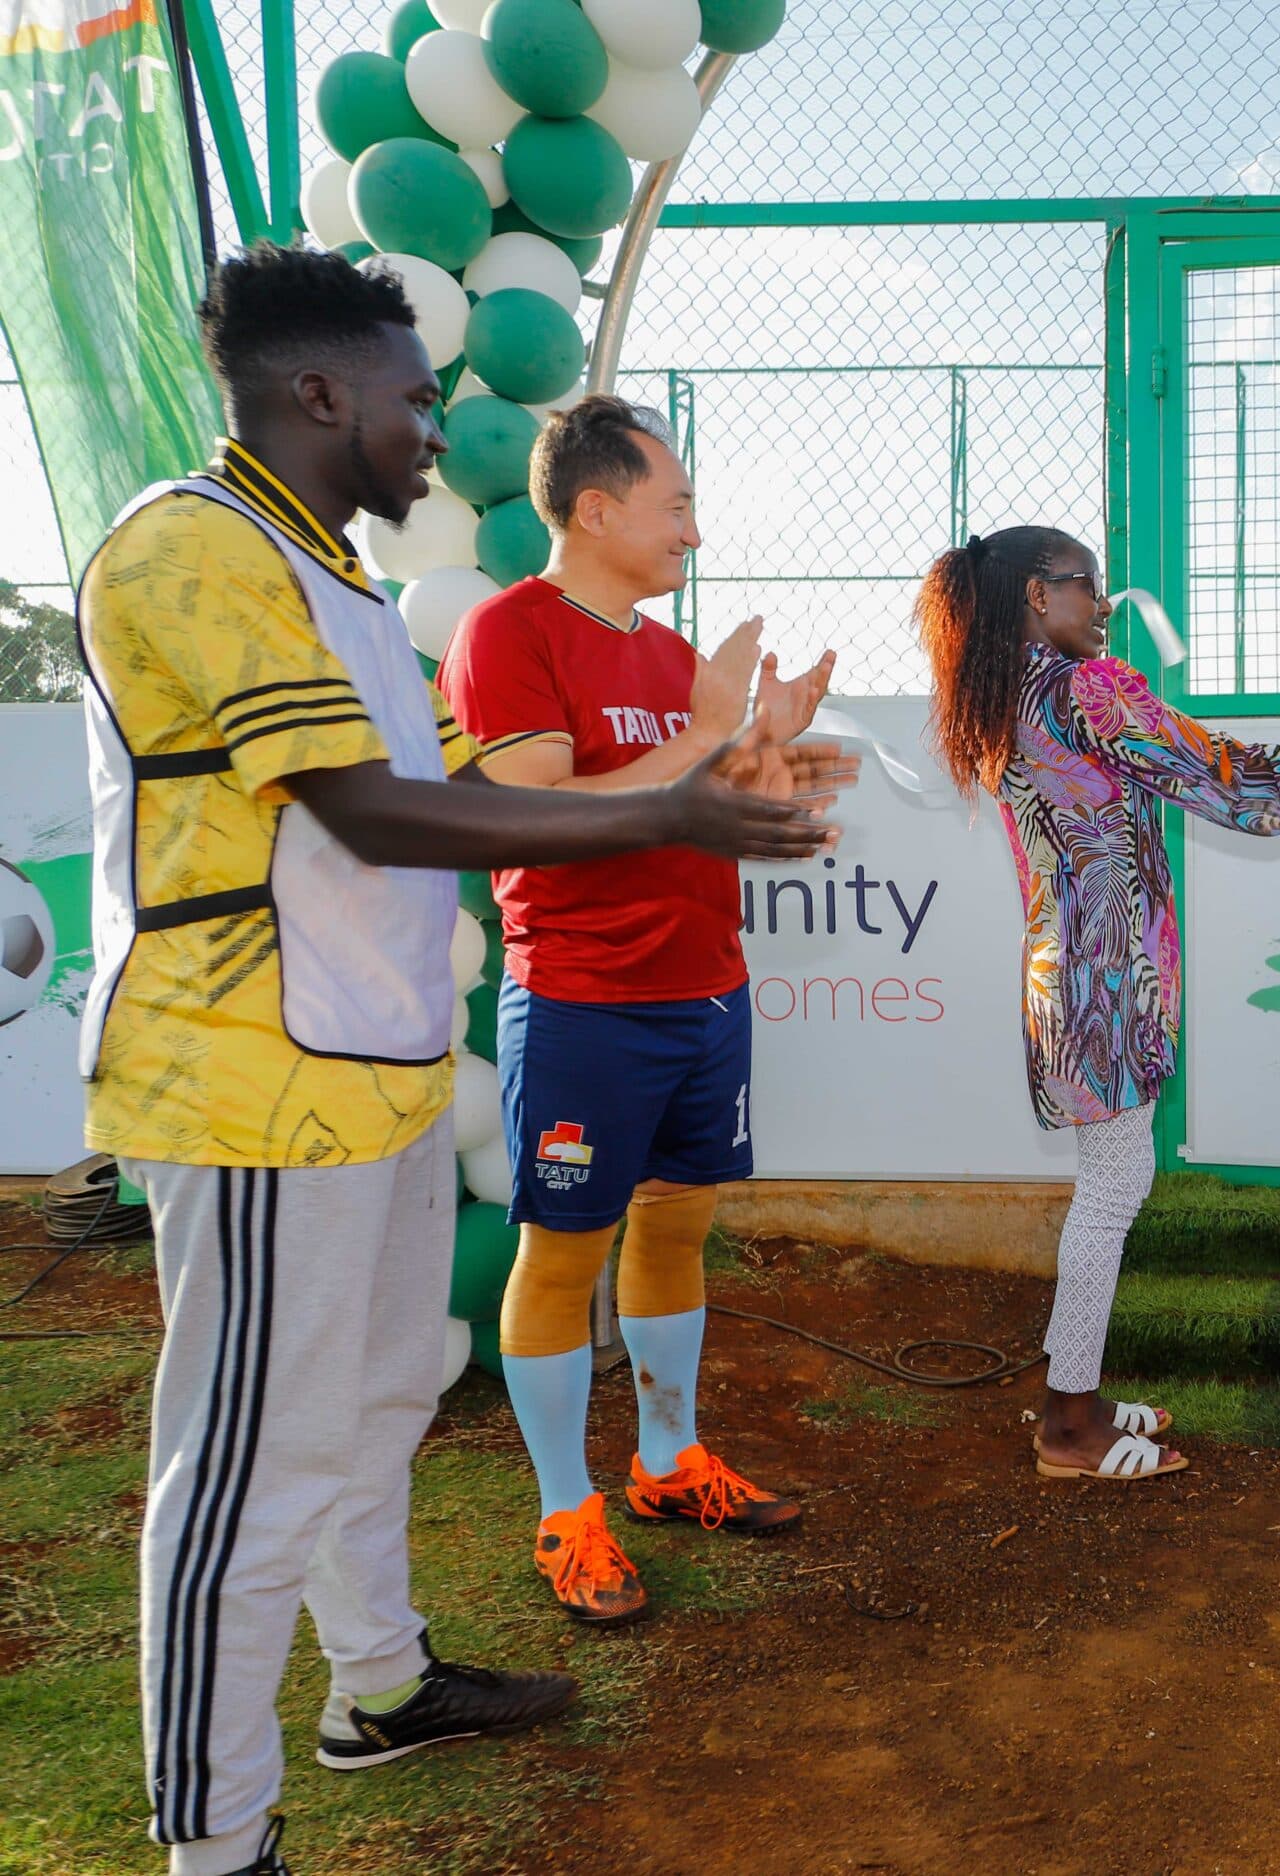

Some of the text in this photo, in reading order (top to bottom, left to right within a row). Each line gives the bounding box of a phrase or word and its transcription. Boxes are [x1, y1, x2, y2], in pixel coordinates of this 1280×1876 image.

[602, 706, 665, 748] TATU
[755, 977, 945, 1022] omes
[535, 1163, 590, 1184] TATU
[546, 1180, 573, 1191] CITY
